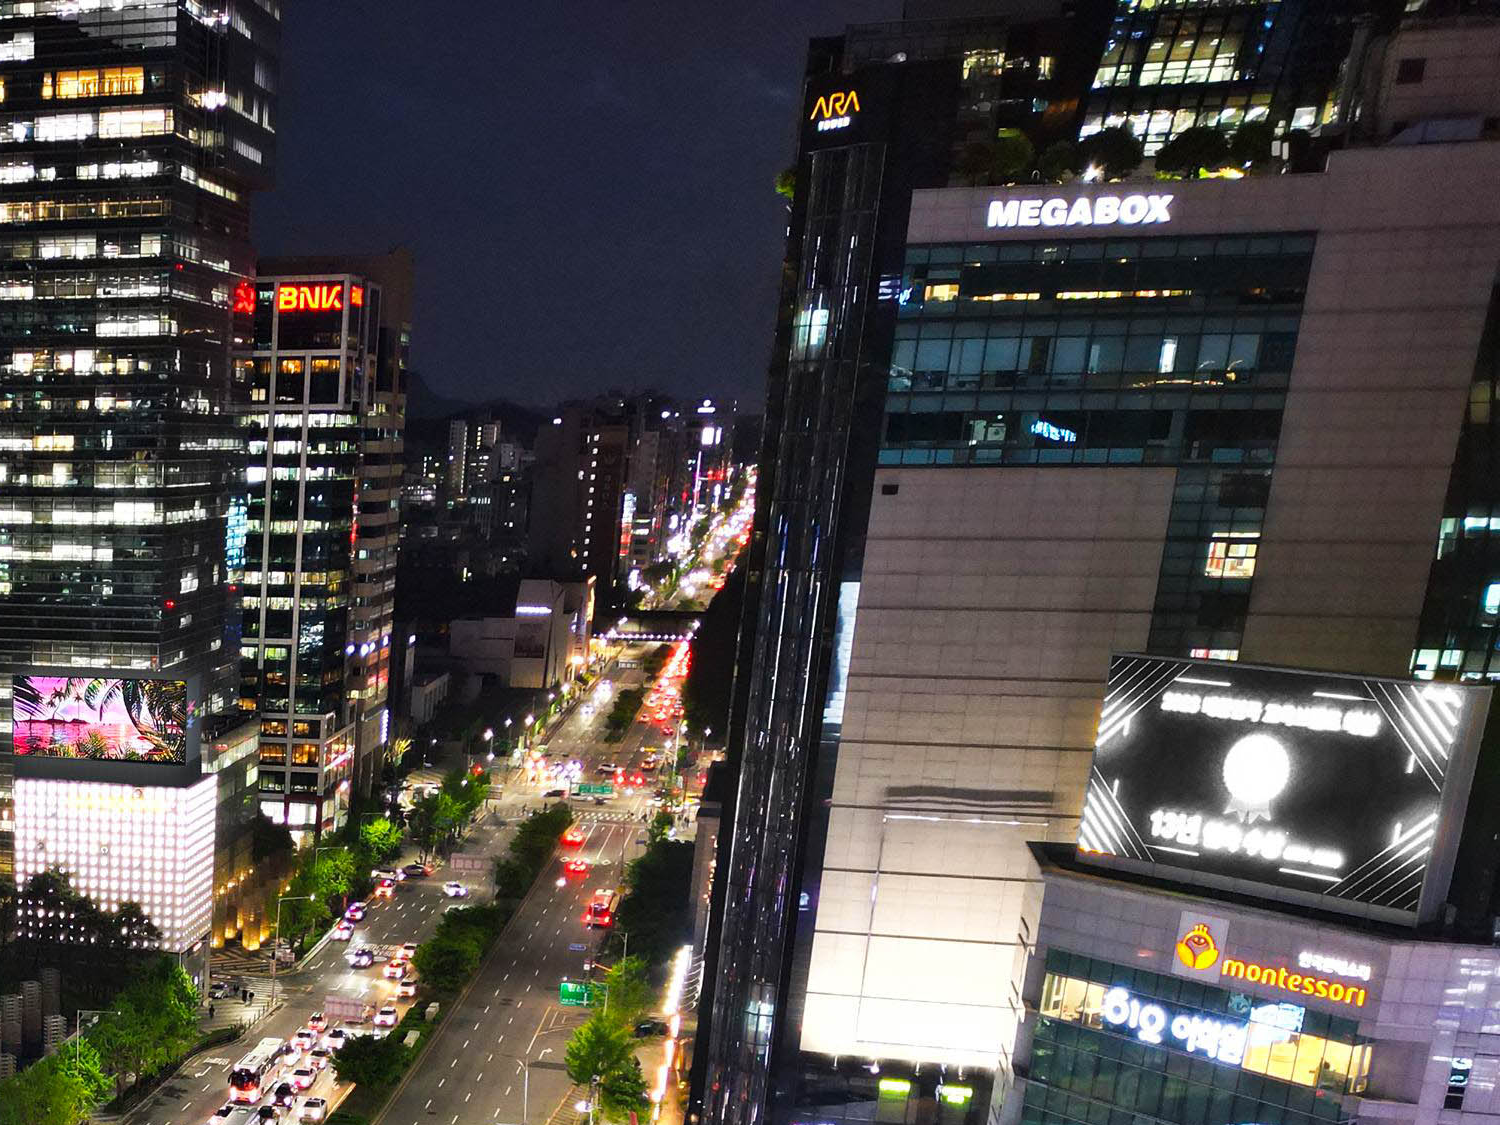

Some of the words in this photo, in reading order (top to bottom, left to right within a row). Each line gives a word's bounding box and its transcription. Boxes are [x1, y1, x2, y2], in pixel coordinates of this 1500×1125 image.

[810, 91, 859, 120] ARA
[987, 194, 1174, 228] MEGABOX
[279, 285, 342, 310] BNK
[1221, 958, 1367, 1007] montessori
